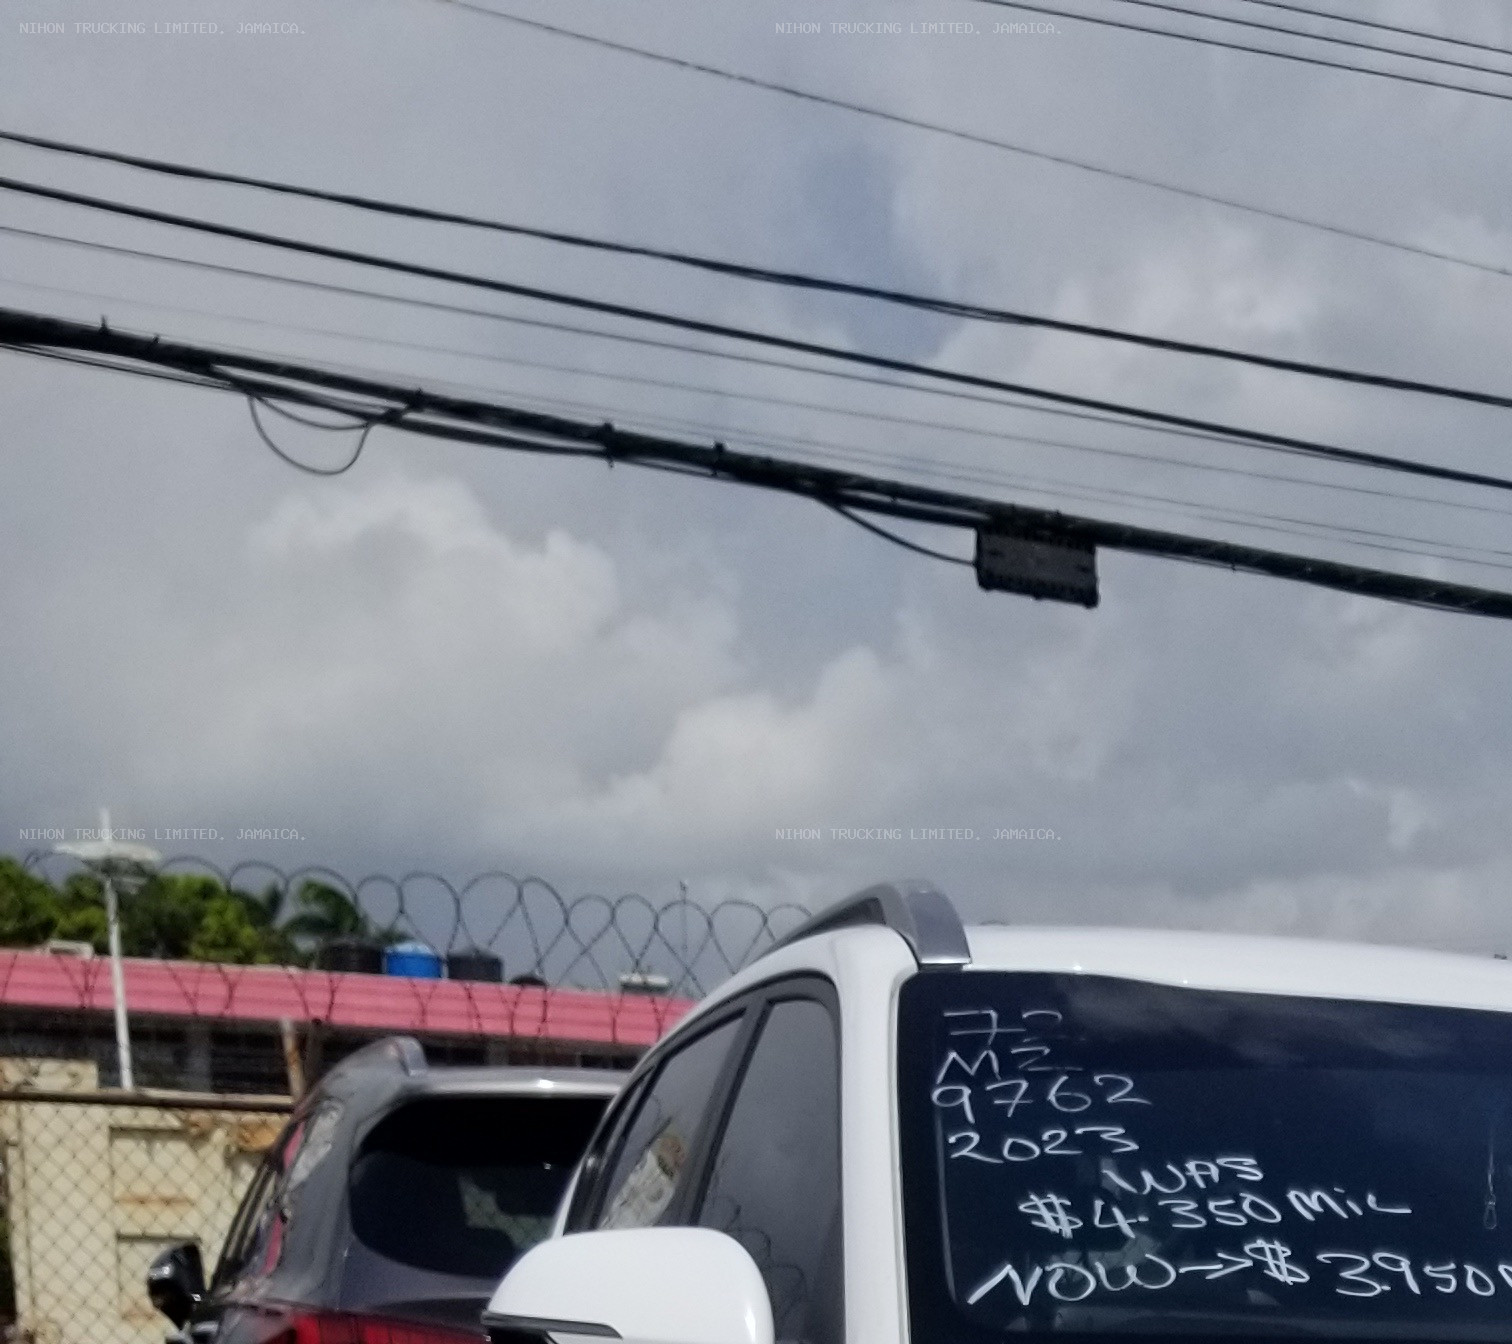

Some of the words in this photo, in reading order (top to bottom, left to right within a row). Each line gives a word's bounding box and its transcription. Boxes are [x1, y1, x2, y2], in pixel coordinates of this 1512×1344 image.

[931, 1073, 1152, 1124] 9762
[948, 1126, 1140, 1164] 2023
[1102, 1157, 1264, 1194] WAS
[969, 1253, 1176, 1305] NOW
